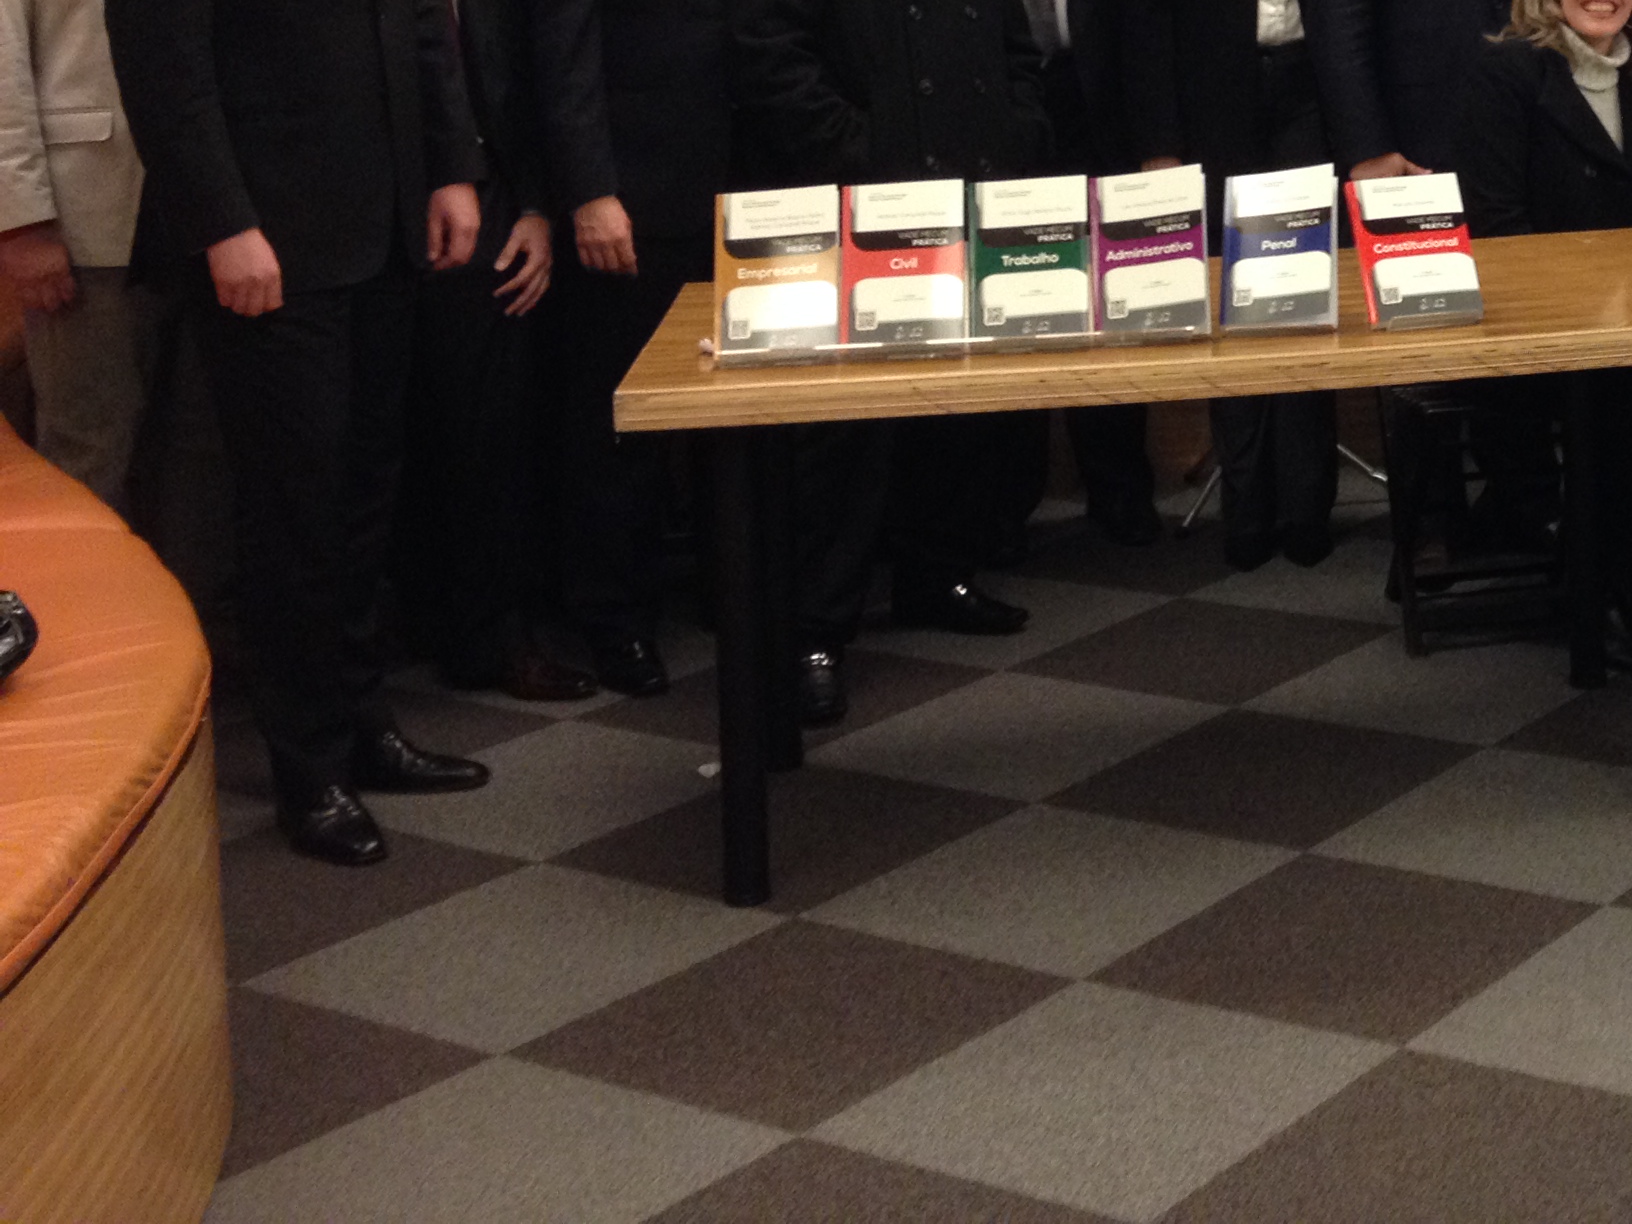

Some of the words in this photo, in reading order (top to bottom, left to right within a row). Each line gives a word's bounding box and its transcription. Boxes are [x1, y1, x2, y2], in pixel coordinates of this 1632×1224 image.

[1105, 241, 1194, 262] Administrativo
[1261, 237, 1297, 251] Penal
[1373, 237, 1459, 254] Constitucional
[889, 257, 919, 270] Civil
[1001, 252, 1060, 267] Trabalho
[737, 263, 818, 280] Empresarial
